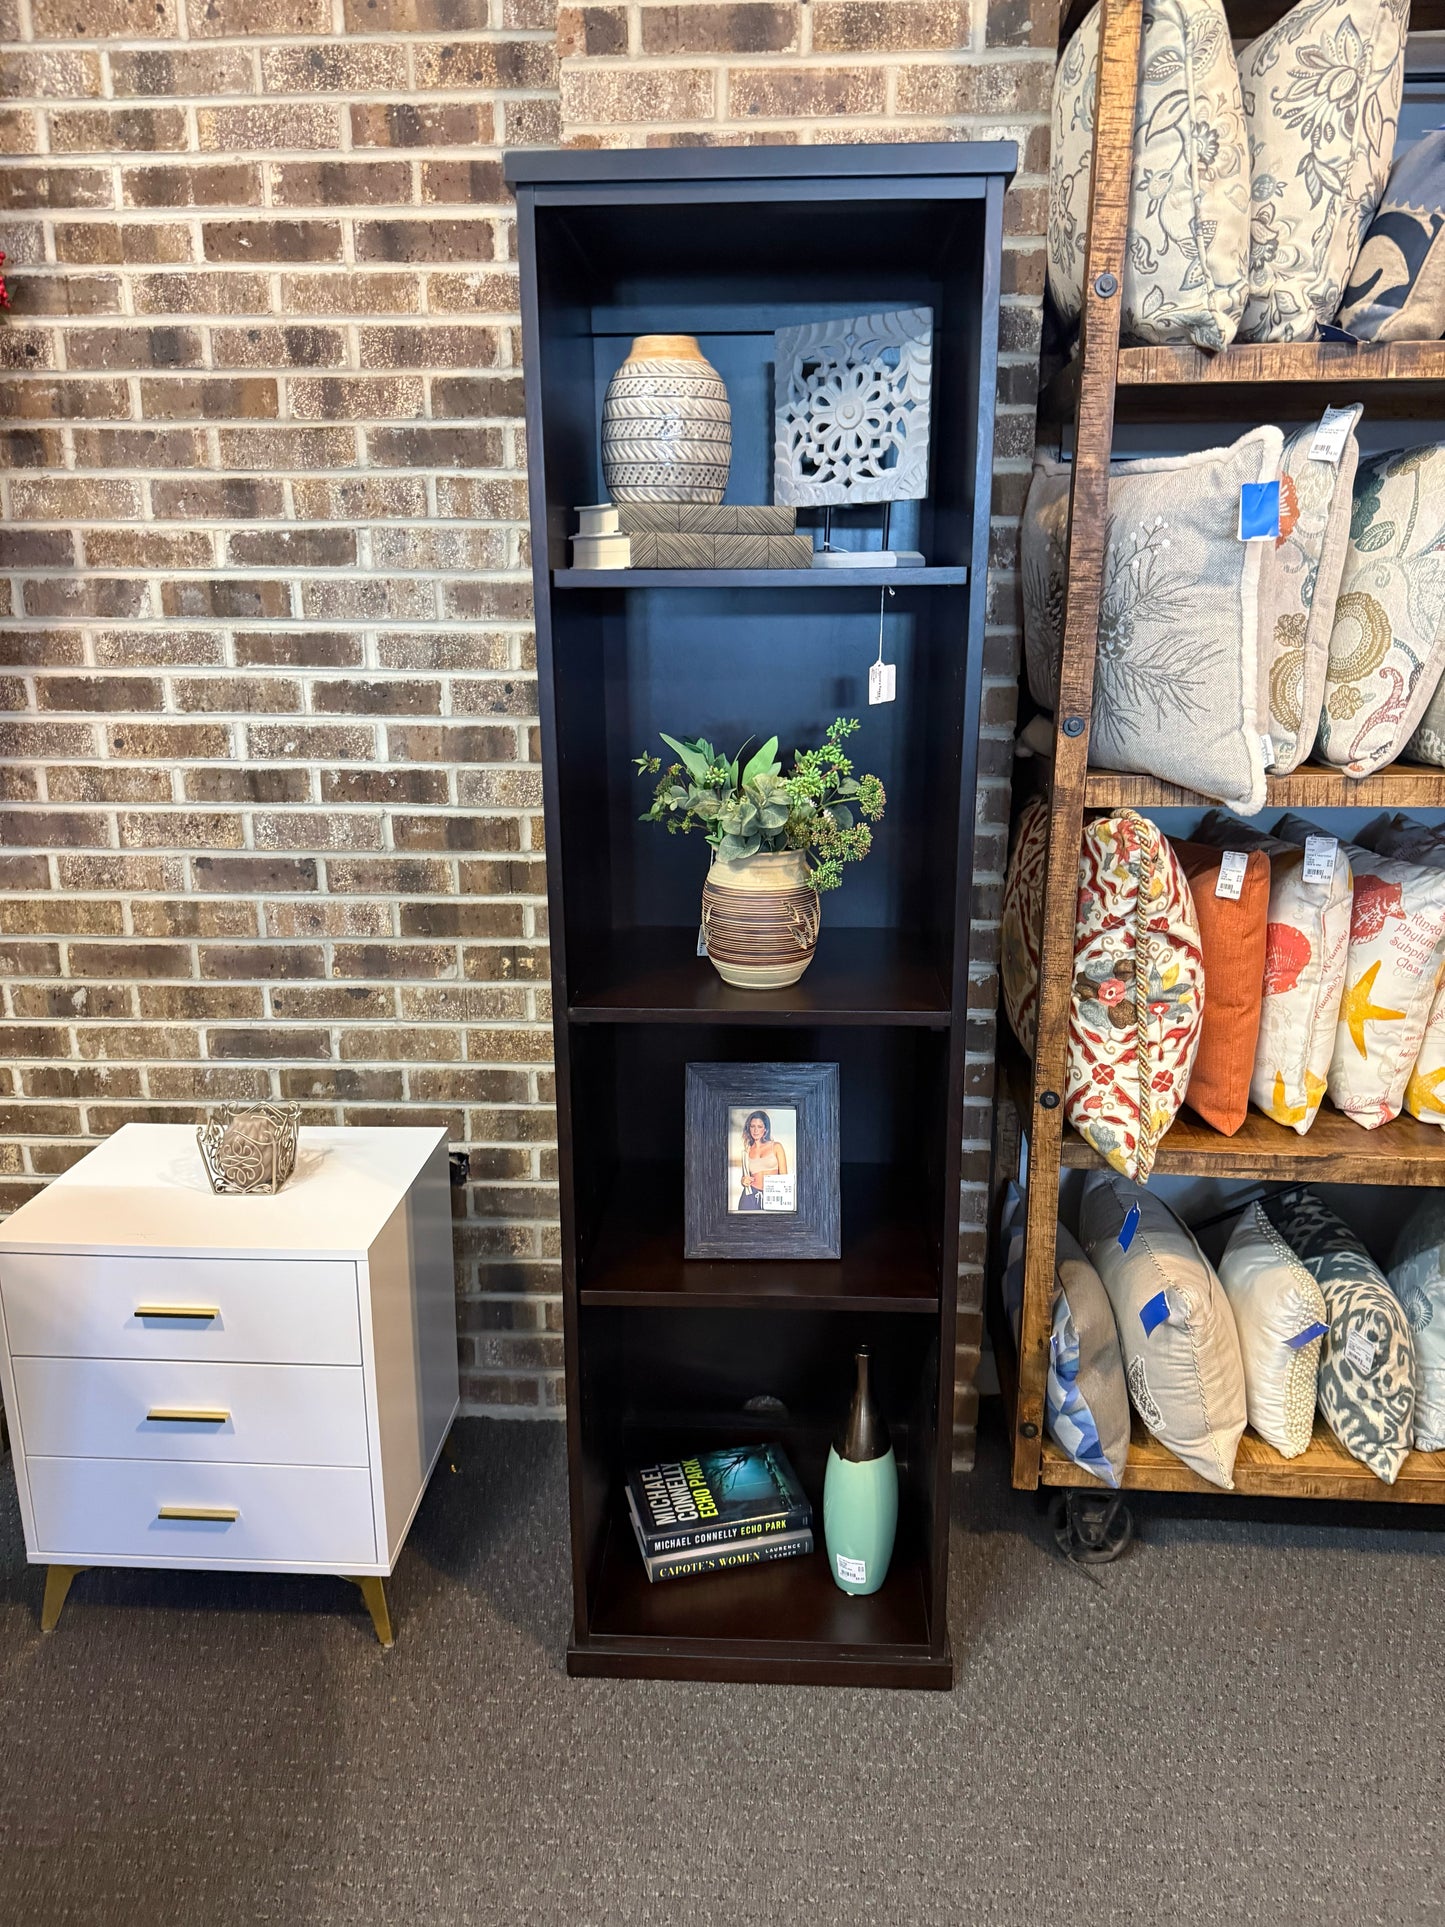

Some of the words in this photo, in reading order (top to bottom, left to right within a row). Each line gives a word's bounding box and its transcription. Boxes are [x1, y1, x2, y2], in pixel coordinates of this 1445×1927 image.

[681, 1458, 707, 1488] PARK
[640, 1464, 678, 1526] MICHAEL
[660, 1463, 699, 1522] CONNELLY
[692, 1488, 719, 1519] ECHO
[654, 1537, 692, 1551] MICHAEL
[694, 1528, 738, 1544] CONNELLY
[740, 1523, 762, 1536] ECHO
[765, 1519, 787, 1531] PARK
[765, 1542, 801, 1554] LAURENCE
[718, 1551, 760, 1567] WOMEN
[769, 1550, 797, 1560] LEAMER
